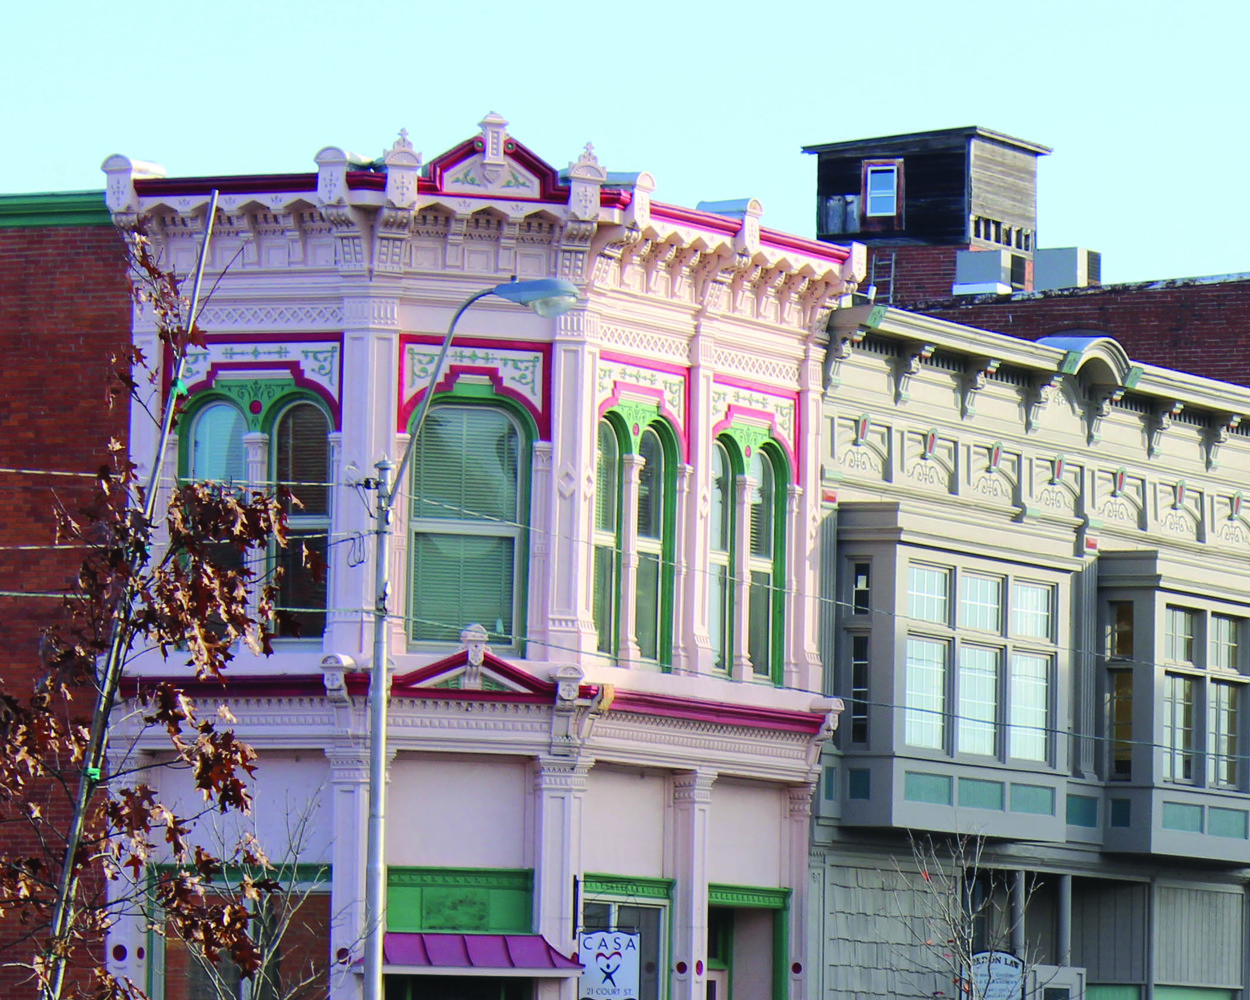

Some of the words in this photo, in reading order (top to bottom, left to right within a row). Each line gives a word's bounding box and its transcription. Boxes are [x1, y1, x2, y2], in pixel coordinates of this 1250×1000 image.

[583, 936, 636, 951] CASA
[1004, 957, 1020, 969] LAW
[586, 987, 594, 995] 21
[596, 987, 620, 996] COURT
